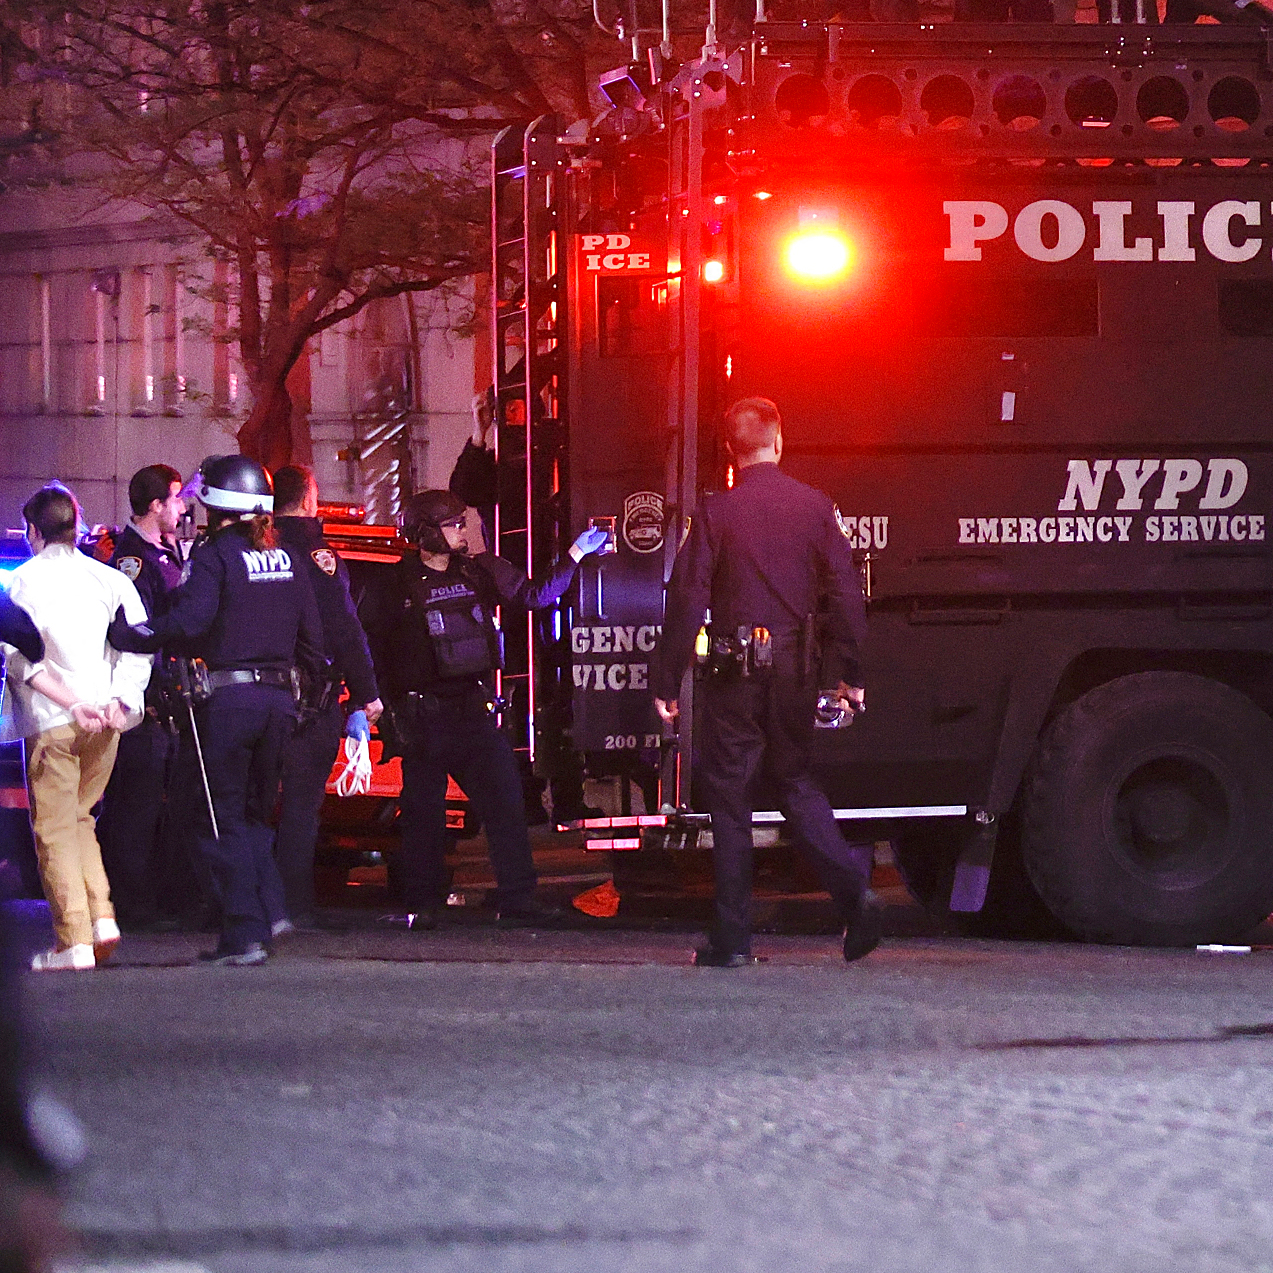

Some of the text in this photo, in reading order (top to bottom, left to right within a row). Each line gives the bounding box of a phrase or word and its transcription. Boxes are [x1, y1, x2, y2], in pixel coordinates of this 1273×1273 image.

[1057, 458, 1249, 511] NYPD
[842, 515, 889, 549] ESU
[958, 515, 1266, 543] EMERGENCY SERVICE
[242, 548, 291, 573] NYPD
[572, 663, 649, 691] VICE
[605, 735, 637, 749] 200
